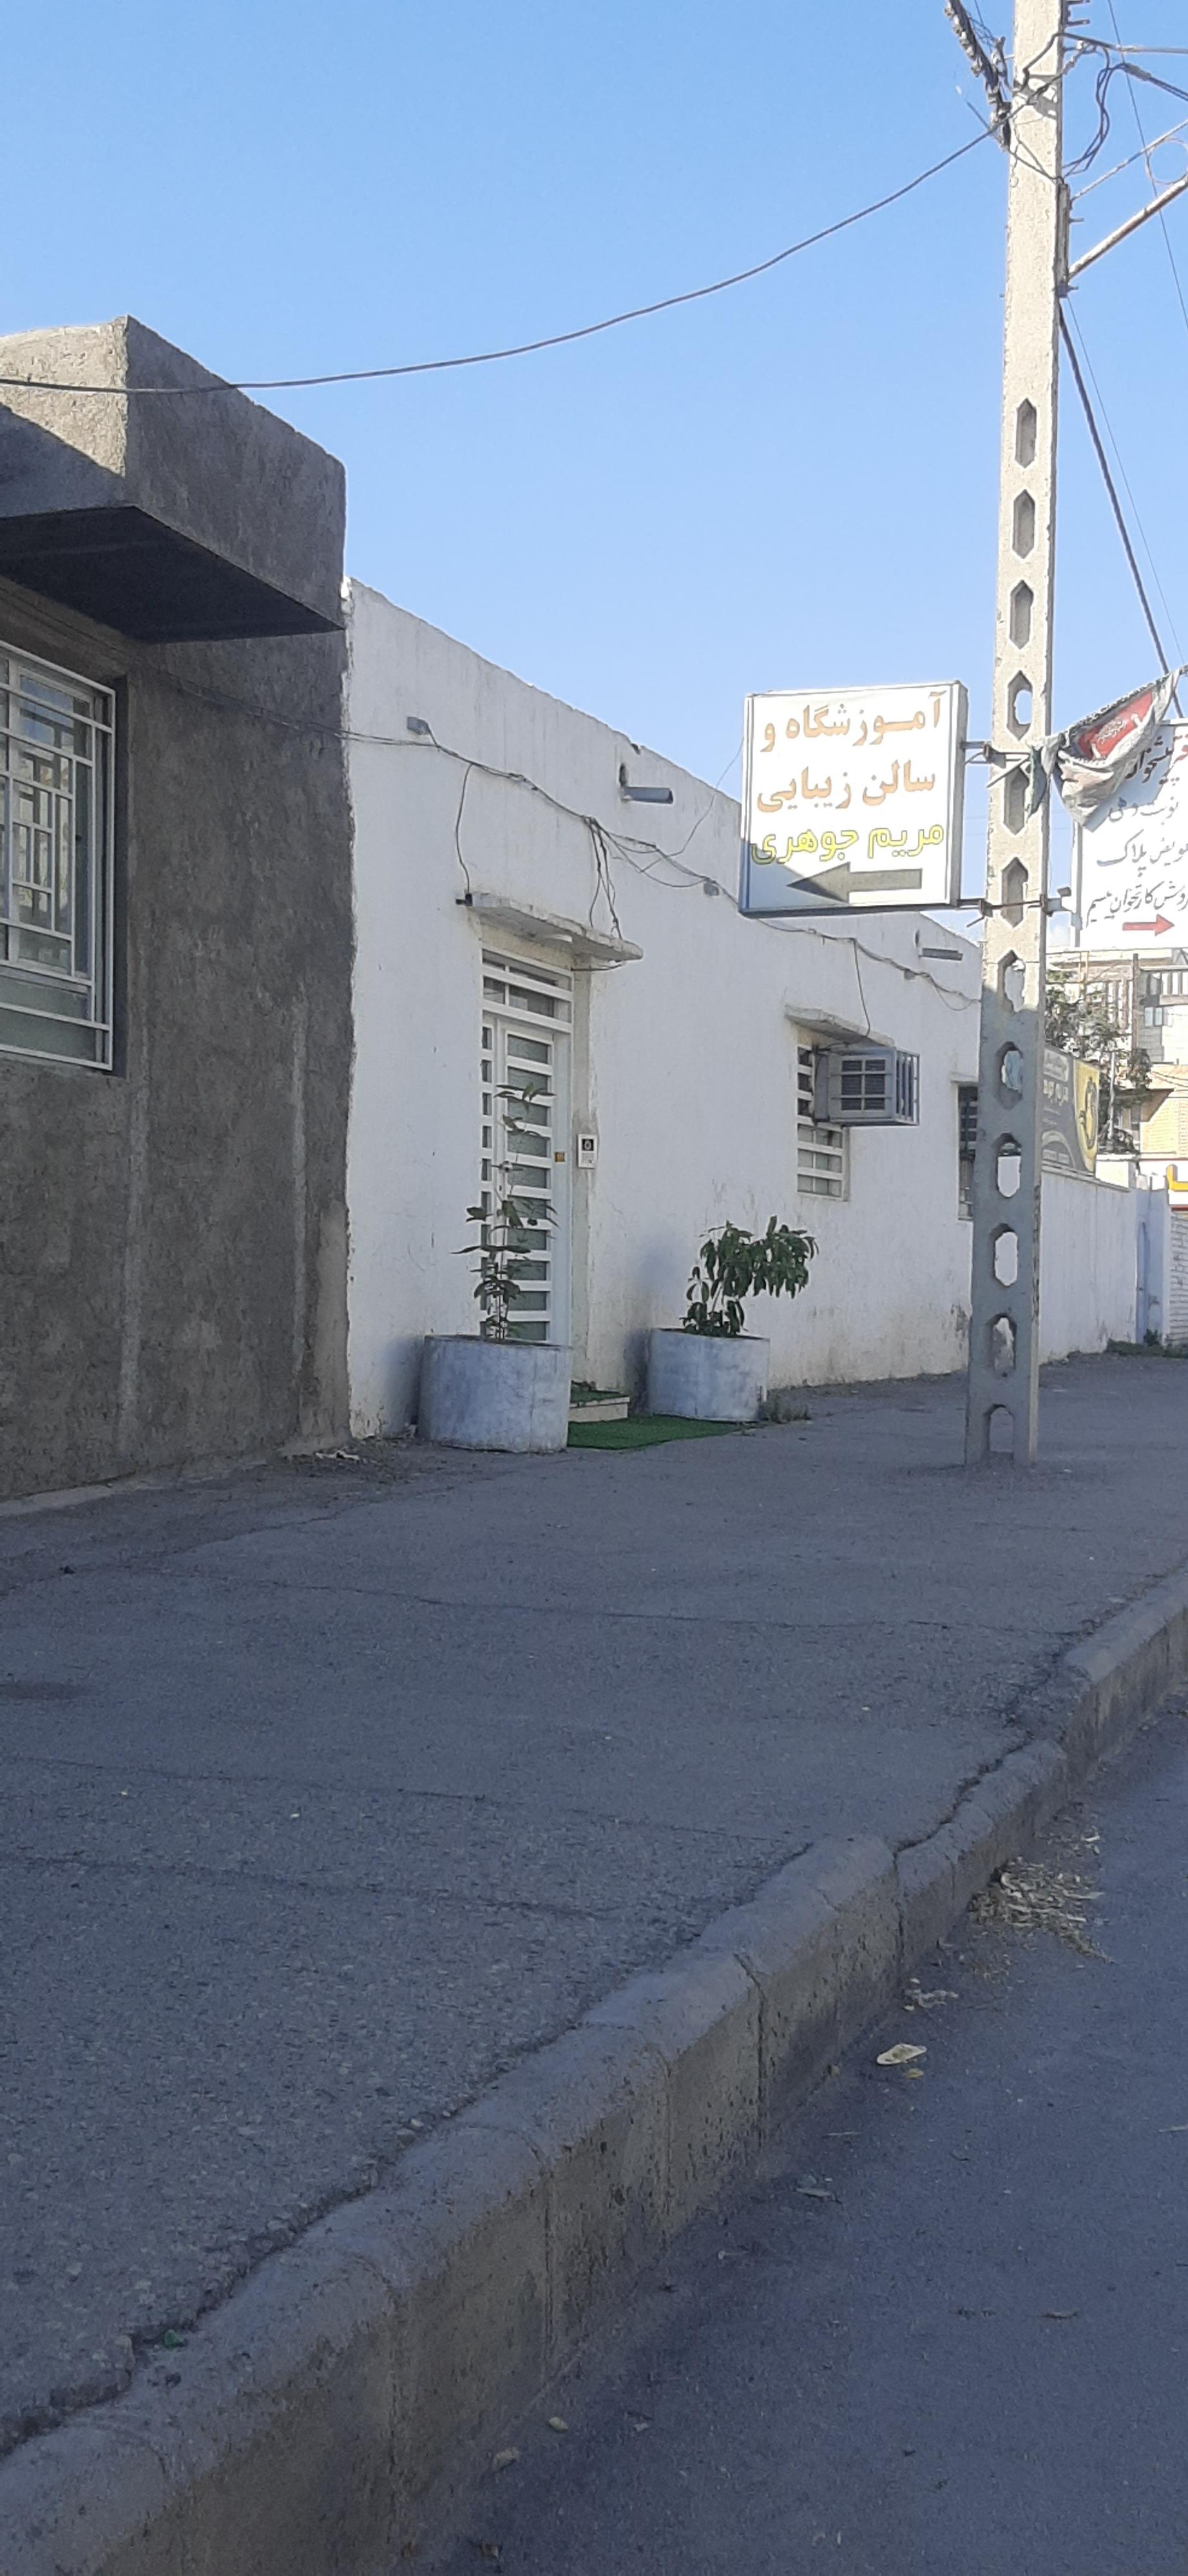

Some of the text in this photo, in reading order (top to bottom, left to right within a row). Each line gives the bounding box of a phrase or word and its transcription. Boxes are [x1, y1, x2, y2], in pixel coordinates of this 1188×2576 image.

[760, 690, 948, 752] آموزشگاه و
[757, 759, 935, 813] سالن زیبایی
[751, 824, 944, 865] مریم جوهری
[1097, 828, 1147, 876] پلاک
[1153, 880, 1188, 912] روش
